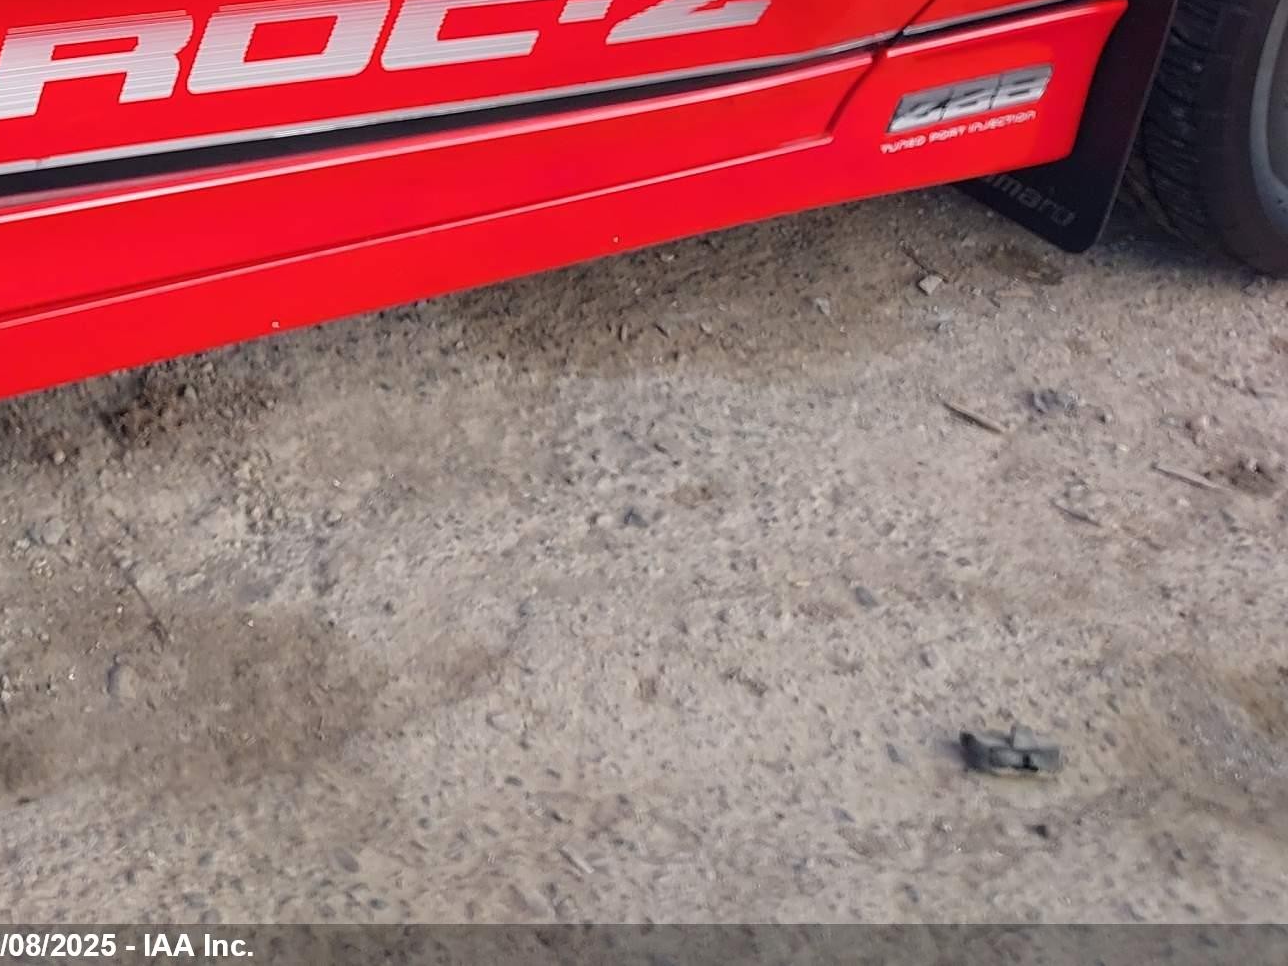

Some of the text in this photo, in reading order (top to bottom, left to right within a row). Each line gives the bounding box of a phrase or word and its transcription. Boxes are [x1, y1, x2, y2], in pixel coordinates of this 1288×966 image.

[880, 110, 1037, 154] TUNED PORT INJECTION
